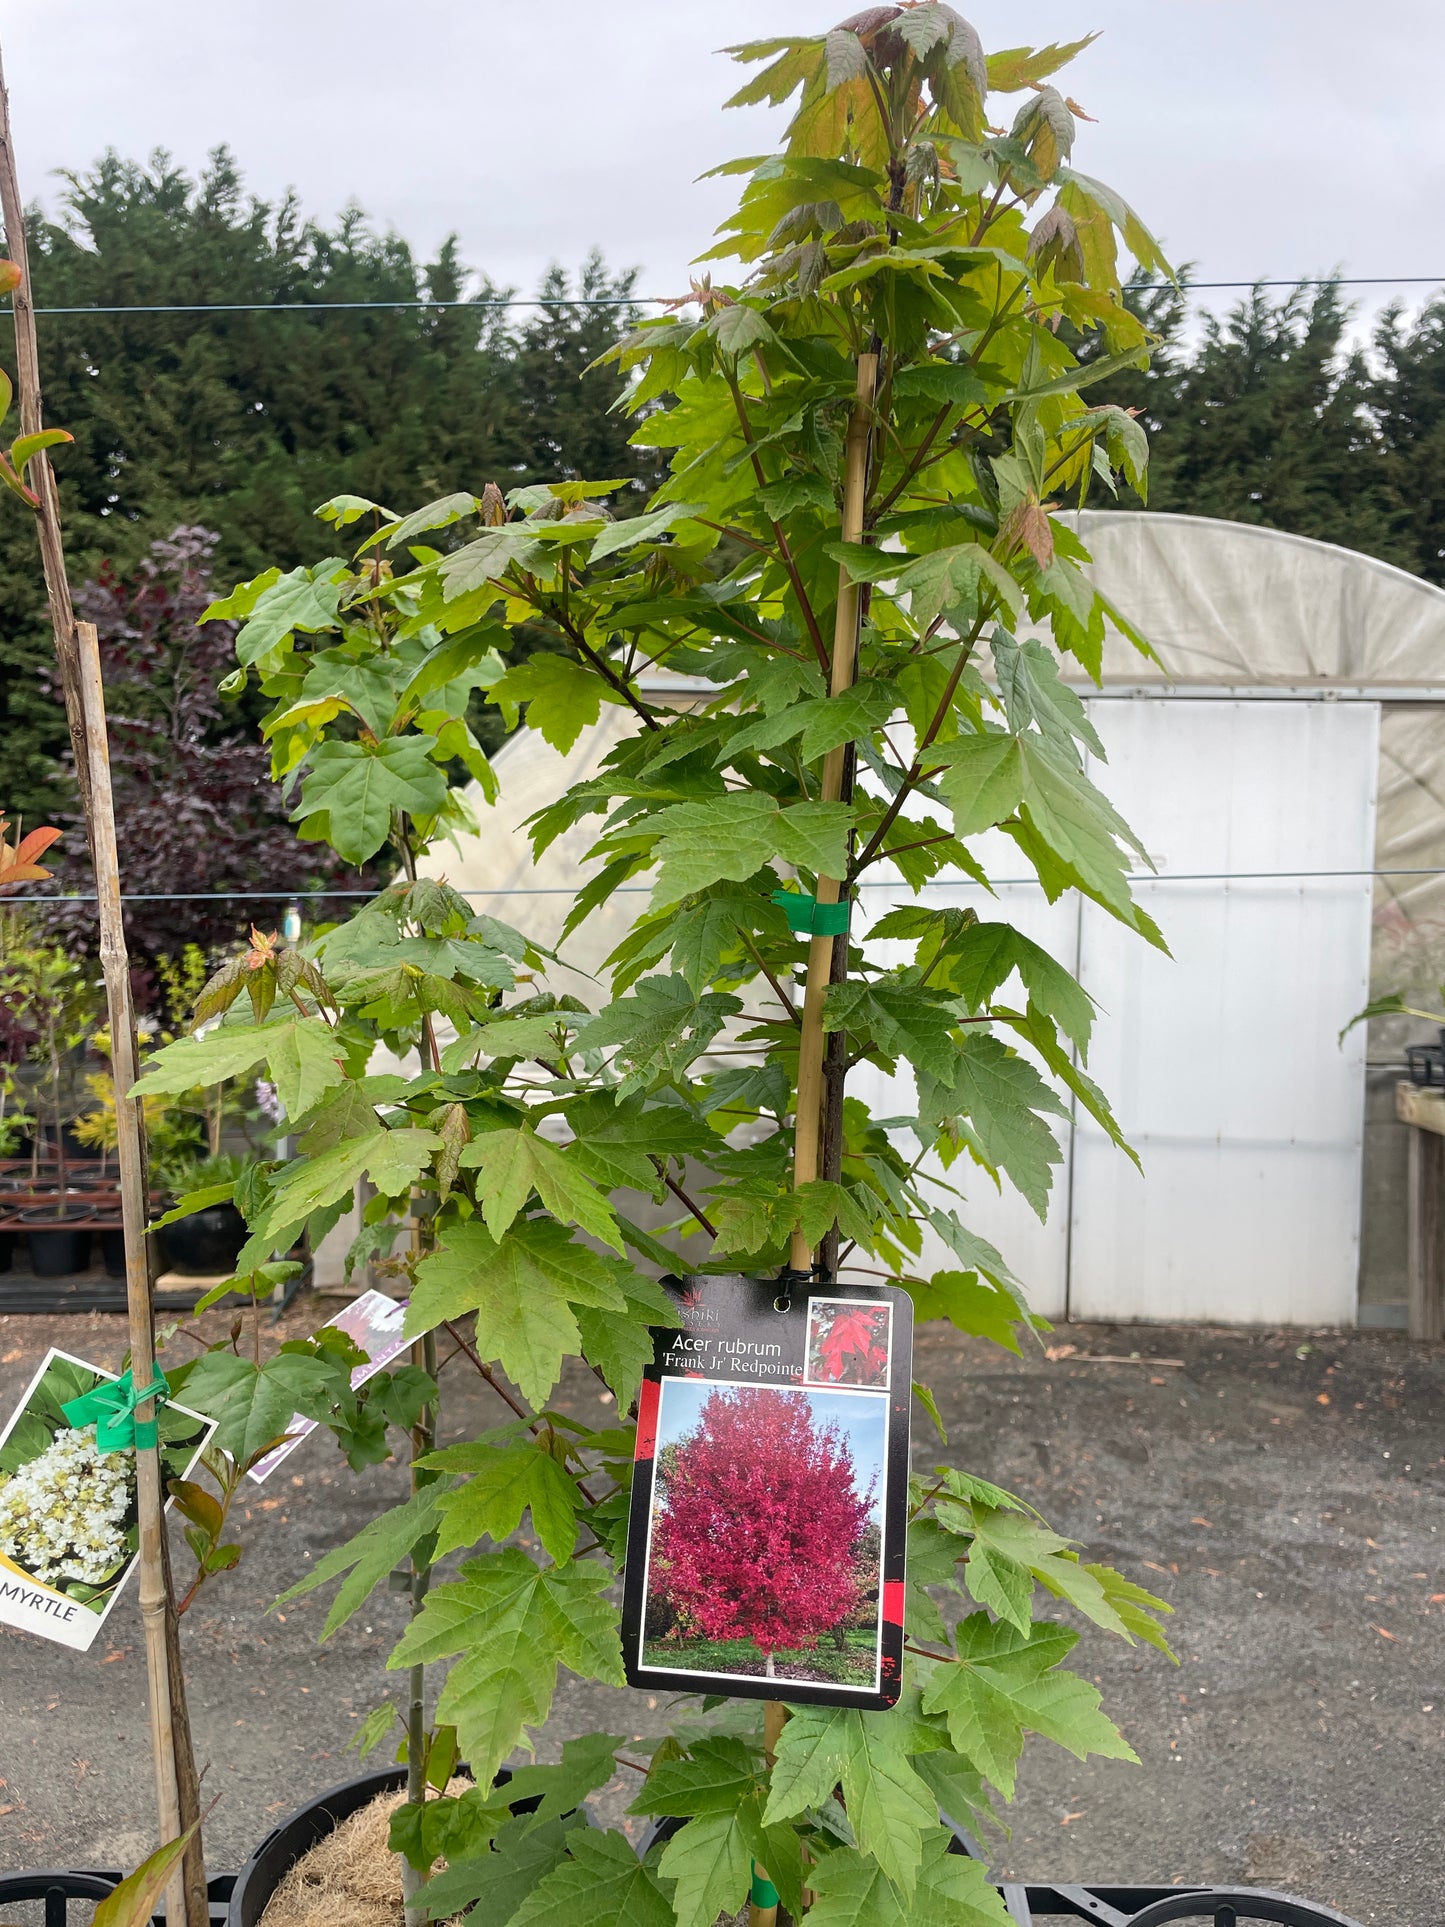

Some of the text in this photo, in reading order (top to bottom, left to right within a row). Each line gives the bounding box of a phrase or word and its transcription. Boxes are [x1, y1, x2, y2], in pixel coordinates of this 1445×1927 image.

[677, 1306, 720, 1321] ishiki
[671, 1334, 781, 1357] Acer rubrum
[662, 1352, 803, 1377] 'Frank Jr' Redpointe
[0, 1582, 78, 1622] MYRTLE
